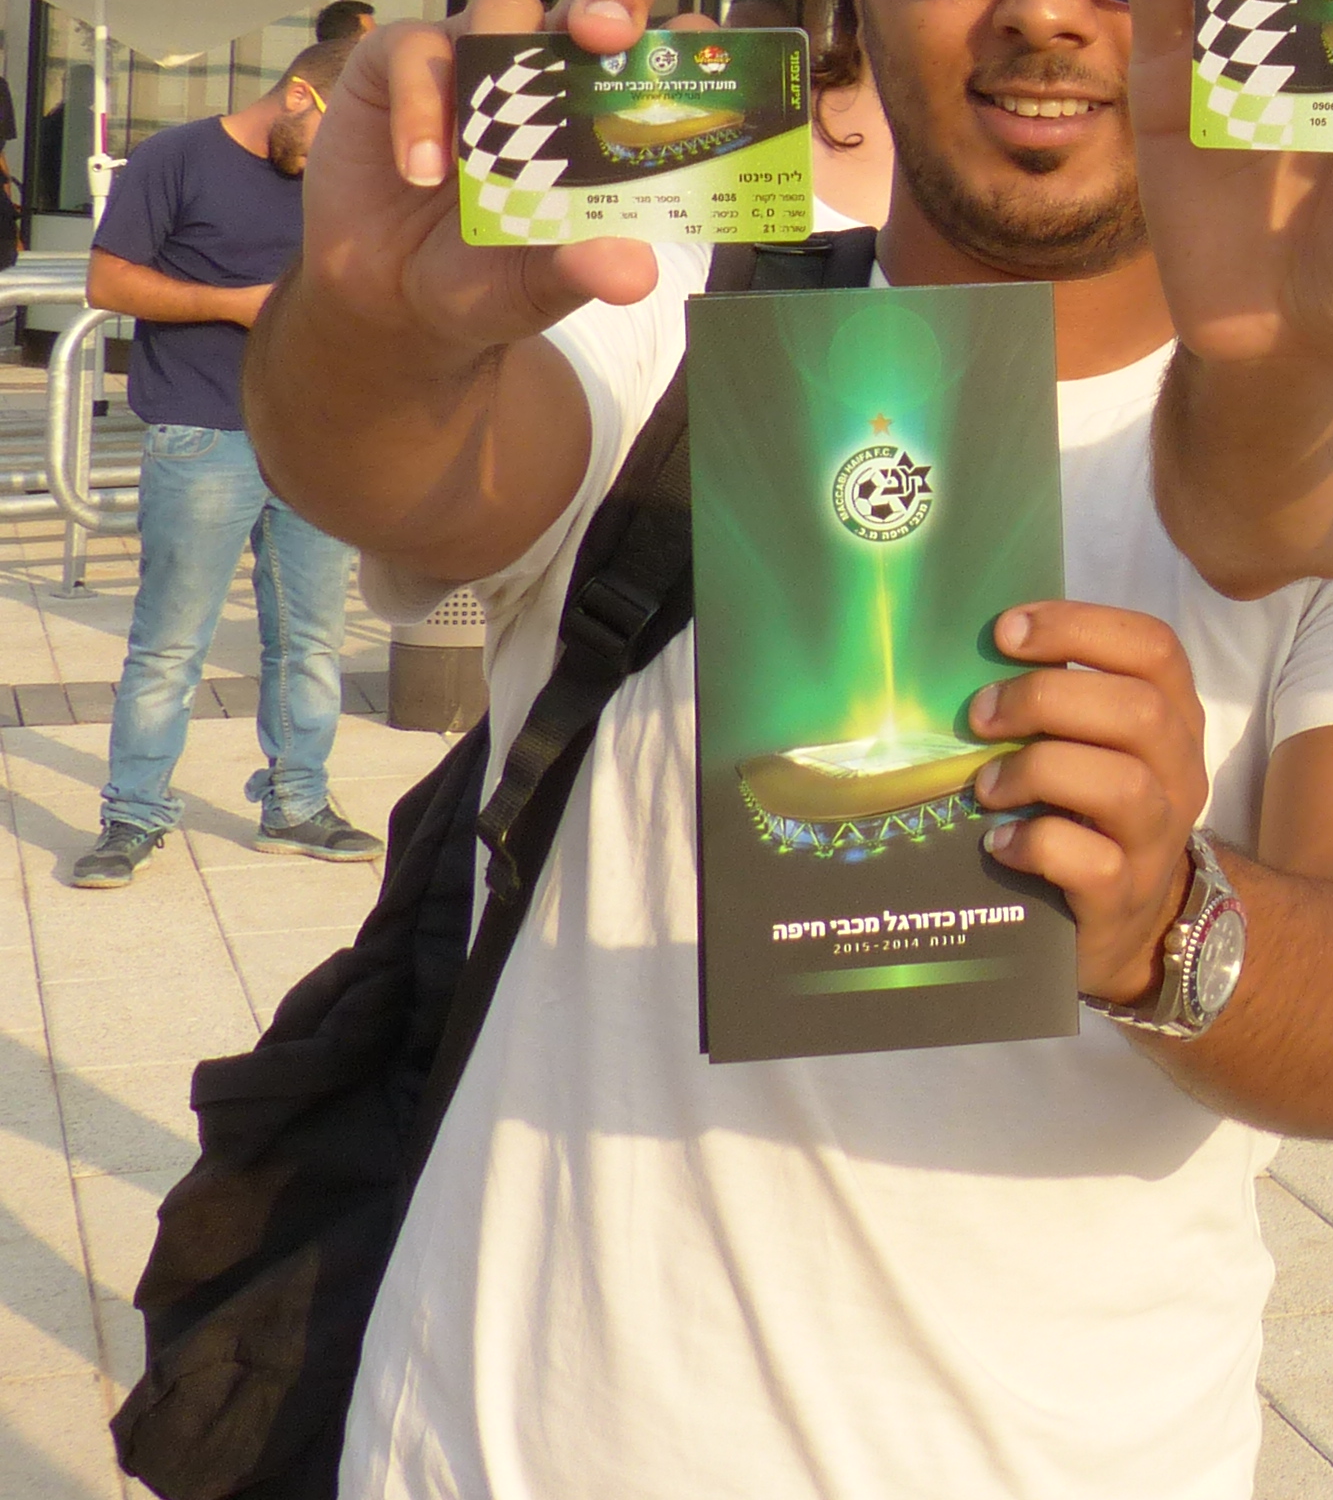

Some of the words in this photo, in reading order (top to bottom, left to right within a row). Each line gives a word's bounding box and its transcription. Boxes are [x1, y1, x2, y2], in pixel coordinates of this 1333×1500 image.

[594, 80, 623, 91] חיפה
[625, 80, 654, 91] מכבי
[658, 79, 697, 91] כדורגל
[699, 80, 737, 92] מועדון
[1309, 118, 1327, 127] 105
[738, 172, 773, 183] פינטו
[777, 170, 802, 185] לירן
[586, 210, 603, 220] 105
[685, 225, 702, 235] 137
[762, 224, 776, 233] 21
[835, 472, 850, 522] MACCABI
[846, 450, 873, 473] HAIFA
[909, 503, 929, 526] מכבי
[881, 526, 910, 540] חיפה
[883, 909, 956, 932] כדורגל
[959, 904, 1026, 930] מועדון
[772, 920, 827, 941] חיפה
[829, 916, 880, 937] מכבי
[929, 933, 967, 948] עונת
